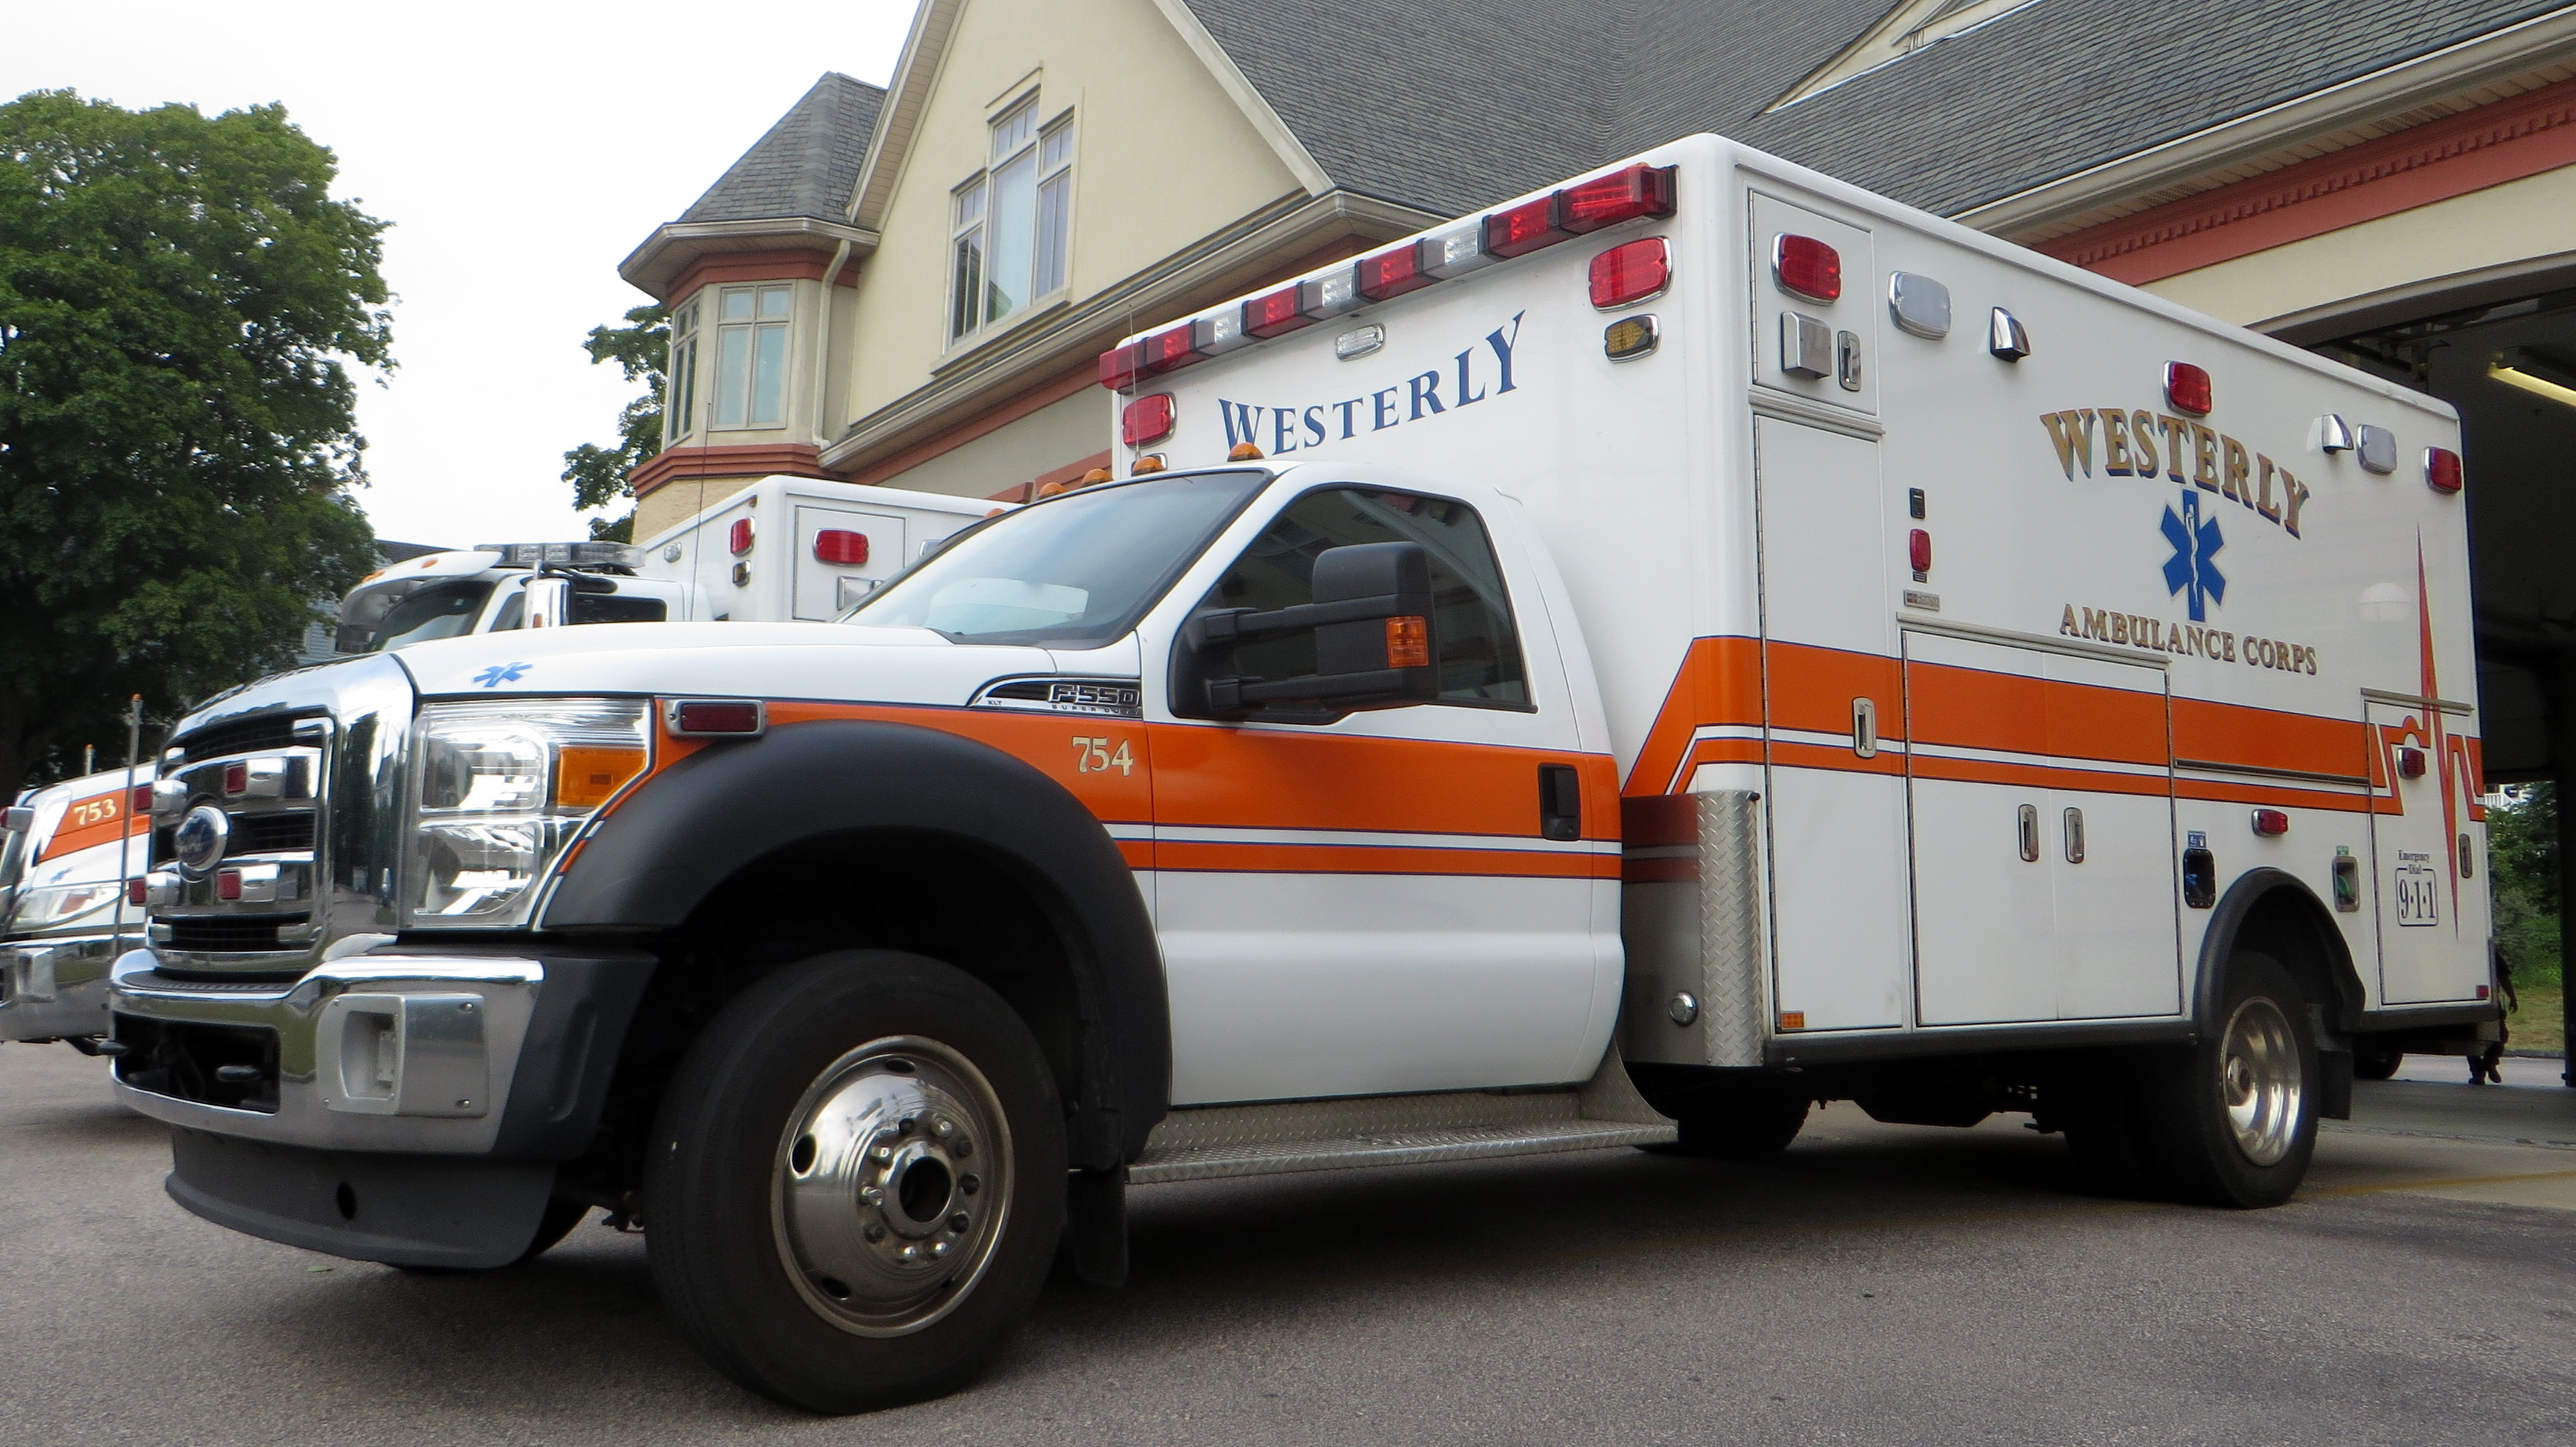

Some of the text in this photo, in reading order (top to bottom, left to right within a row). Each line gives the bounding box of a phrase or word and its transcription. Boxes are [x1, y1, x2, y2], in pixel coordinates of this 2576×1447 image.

[1218, 308, 1526, 456] WESTERLY
[2040, 407, 2310, 541] WESTERLY
[2059, 604, 2317, 676] AMBULANCE CORPS
[1052, 703, 1097, 712] SUPER
[1072, 736, 1134, 777] 754
[73, 798, 117, 826] 753
